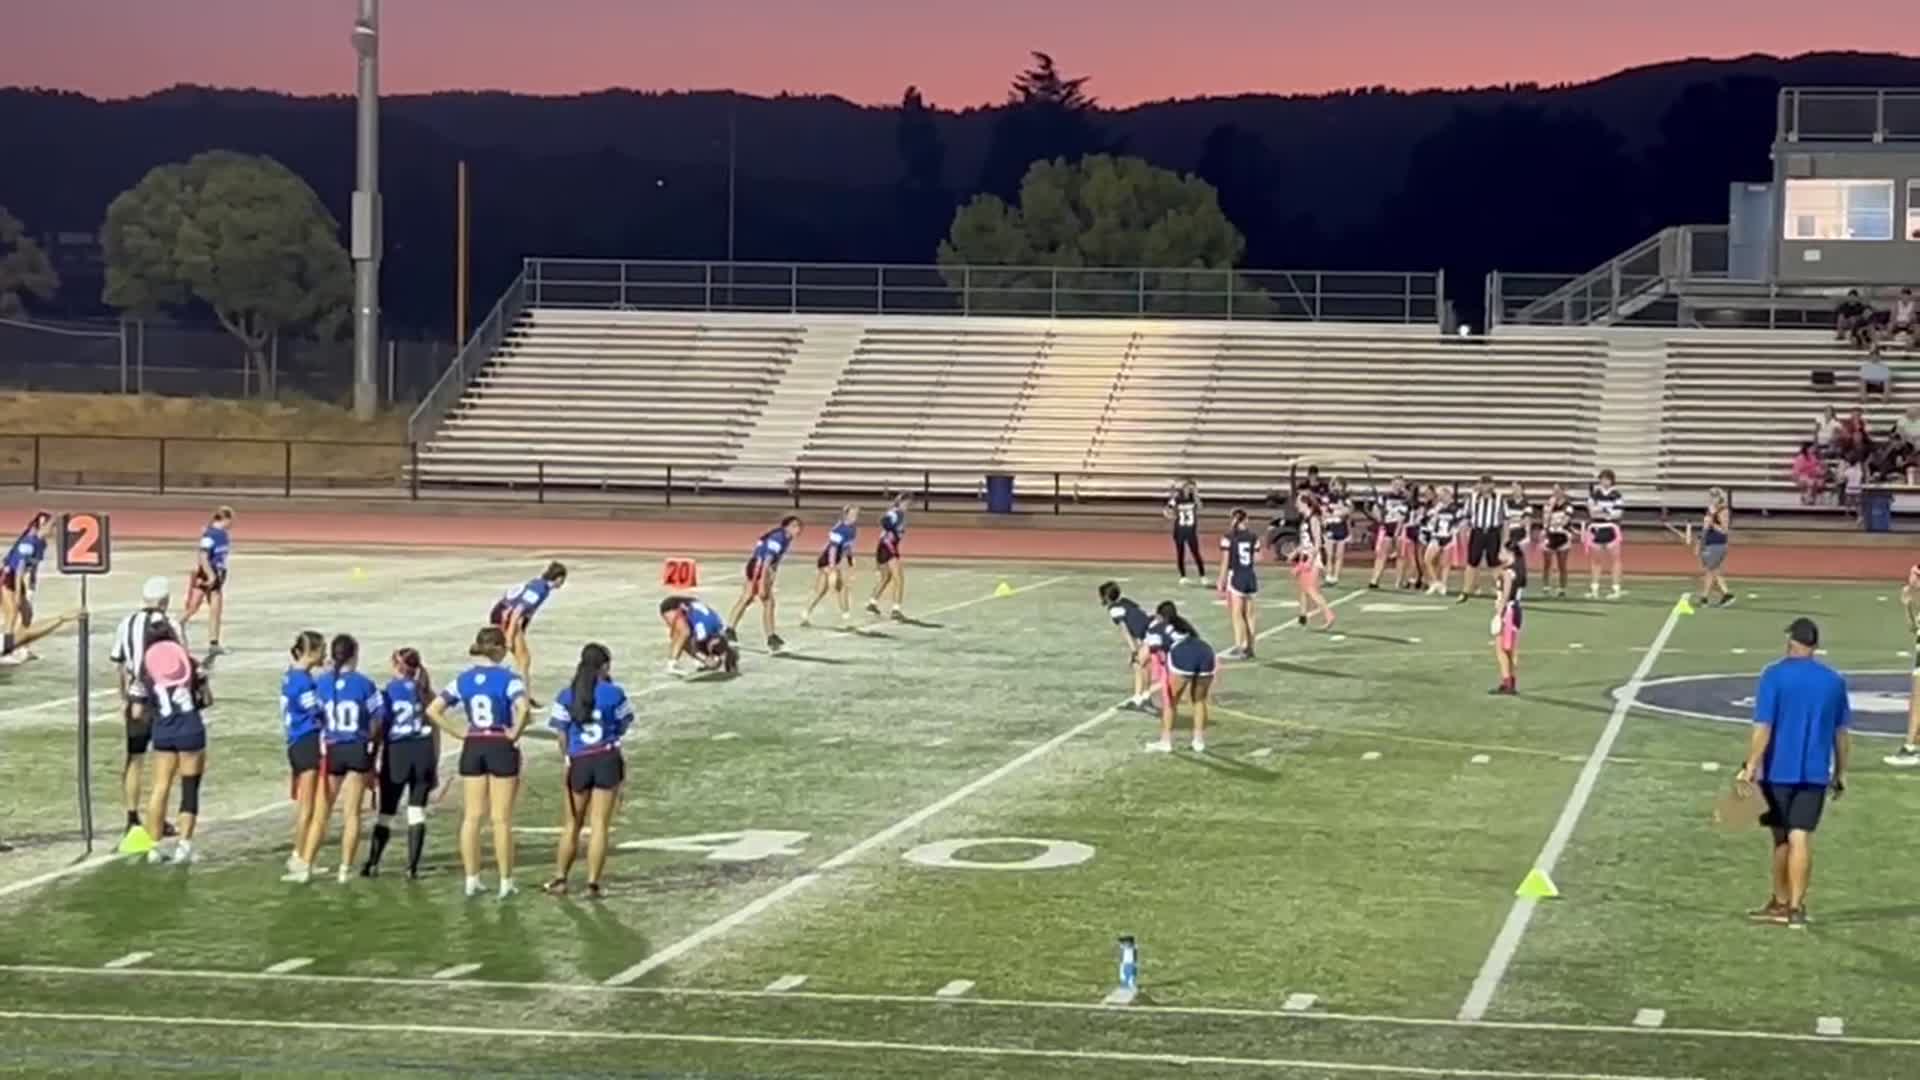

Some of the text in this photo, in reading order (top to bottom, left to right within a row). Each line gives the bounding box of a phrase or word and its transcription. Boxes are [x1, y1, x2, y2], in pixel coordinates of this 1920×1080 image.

[66, 514, 100, 564] 2
[1238, 542, 1251, 566] 5
[665, 561, 689, 584] 20
[325, 699, 359, 732] 10
[470, 693, 494, 728] 8
